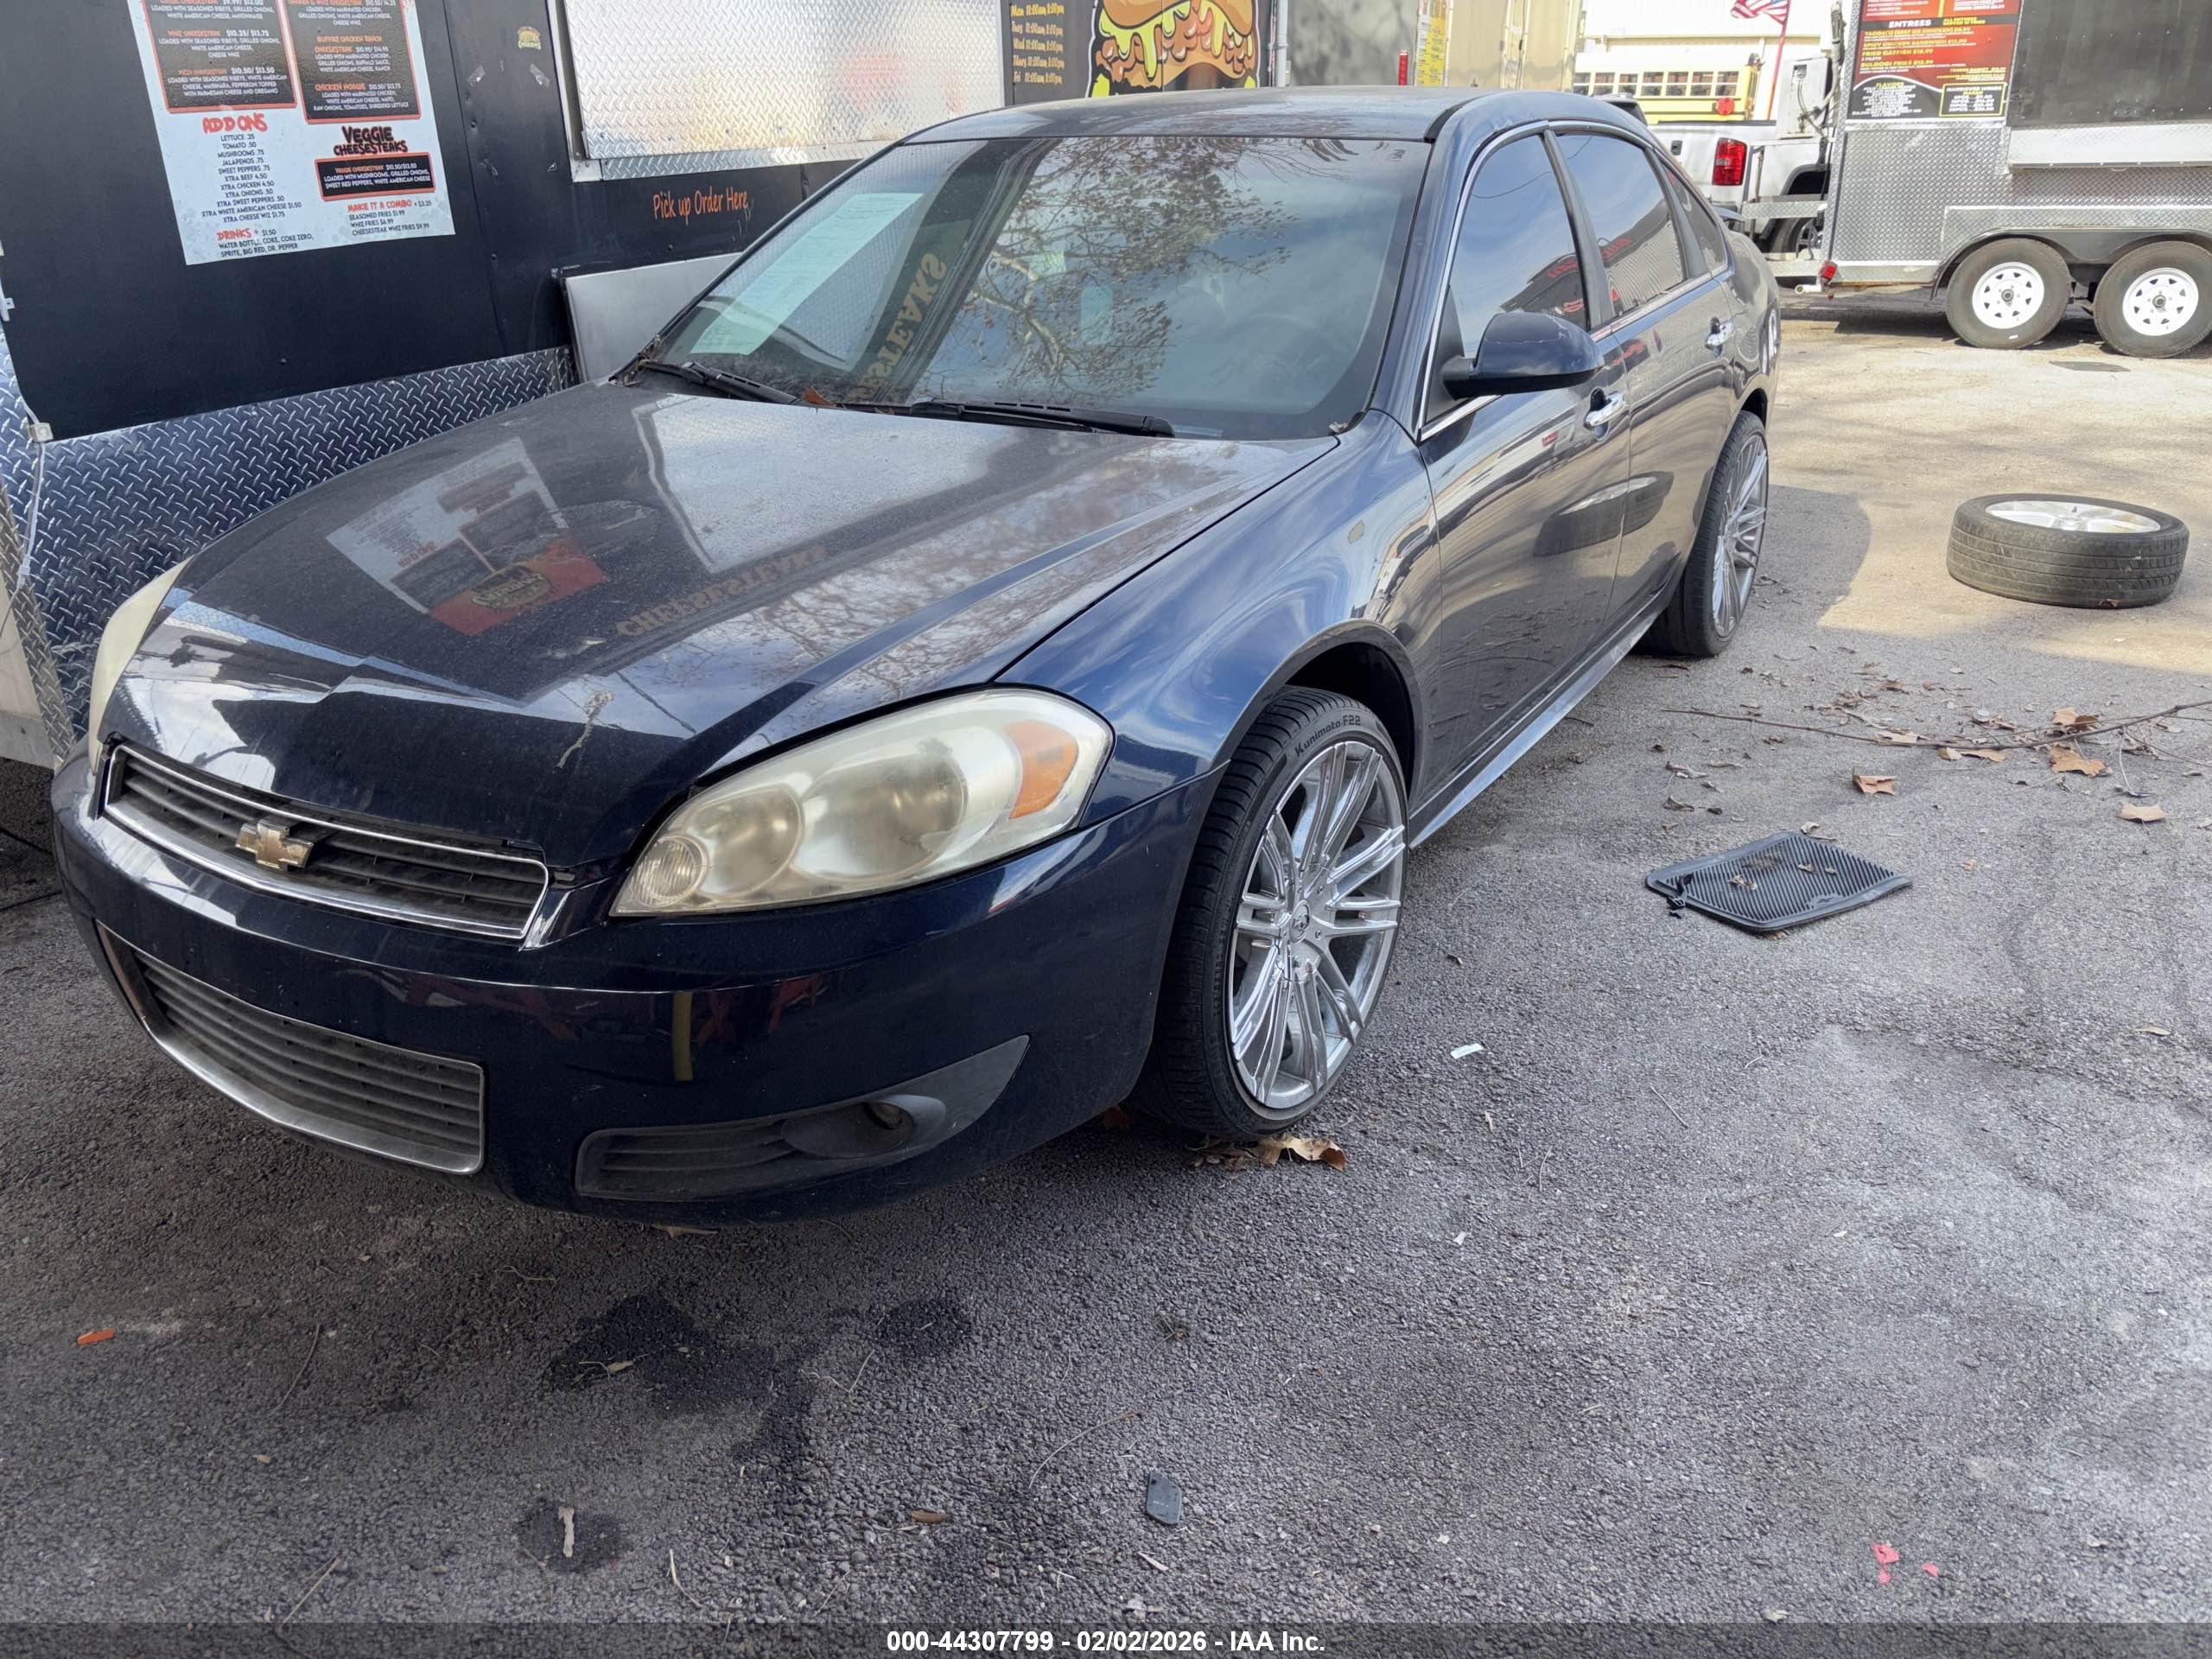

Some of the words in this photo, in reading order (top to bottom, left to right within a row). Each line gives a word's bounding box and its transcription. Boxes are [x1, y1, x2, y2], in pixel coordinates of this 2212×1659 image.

[341, 126, 395, 143] VEGGIE
[334, 140, 408, 156] CHEESESTEAKS
[237, 181, 261, 189] CHICKEN
[386, 199, 411, 207] COMBO
[653, 190, 676, 219] Pick
[678, 196, 691, 225] up
[694, 186, 723, 214] Order
[727, 186, 748, 211] Here
[237, 205, 266, 213] AMERICAN
[349, 212, 378, 220] SEASONED
[217, 228, 252, 240] DRINKS
[219, 240, 238, 249] WATER
[1294, 721, 1340, 757] Kunimoto
[1343, 715, 1361, 726] F22
